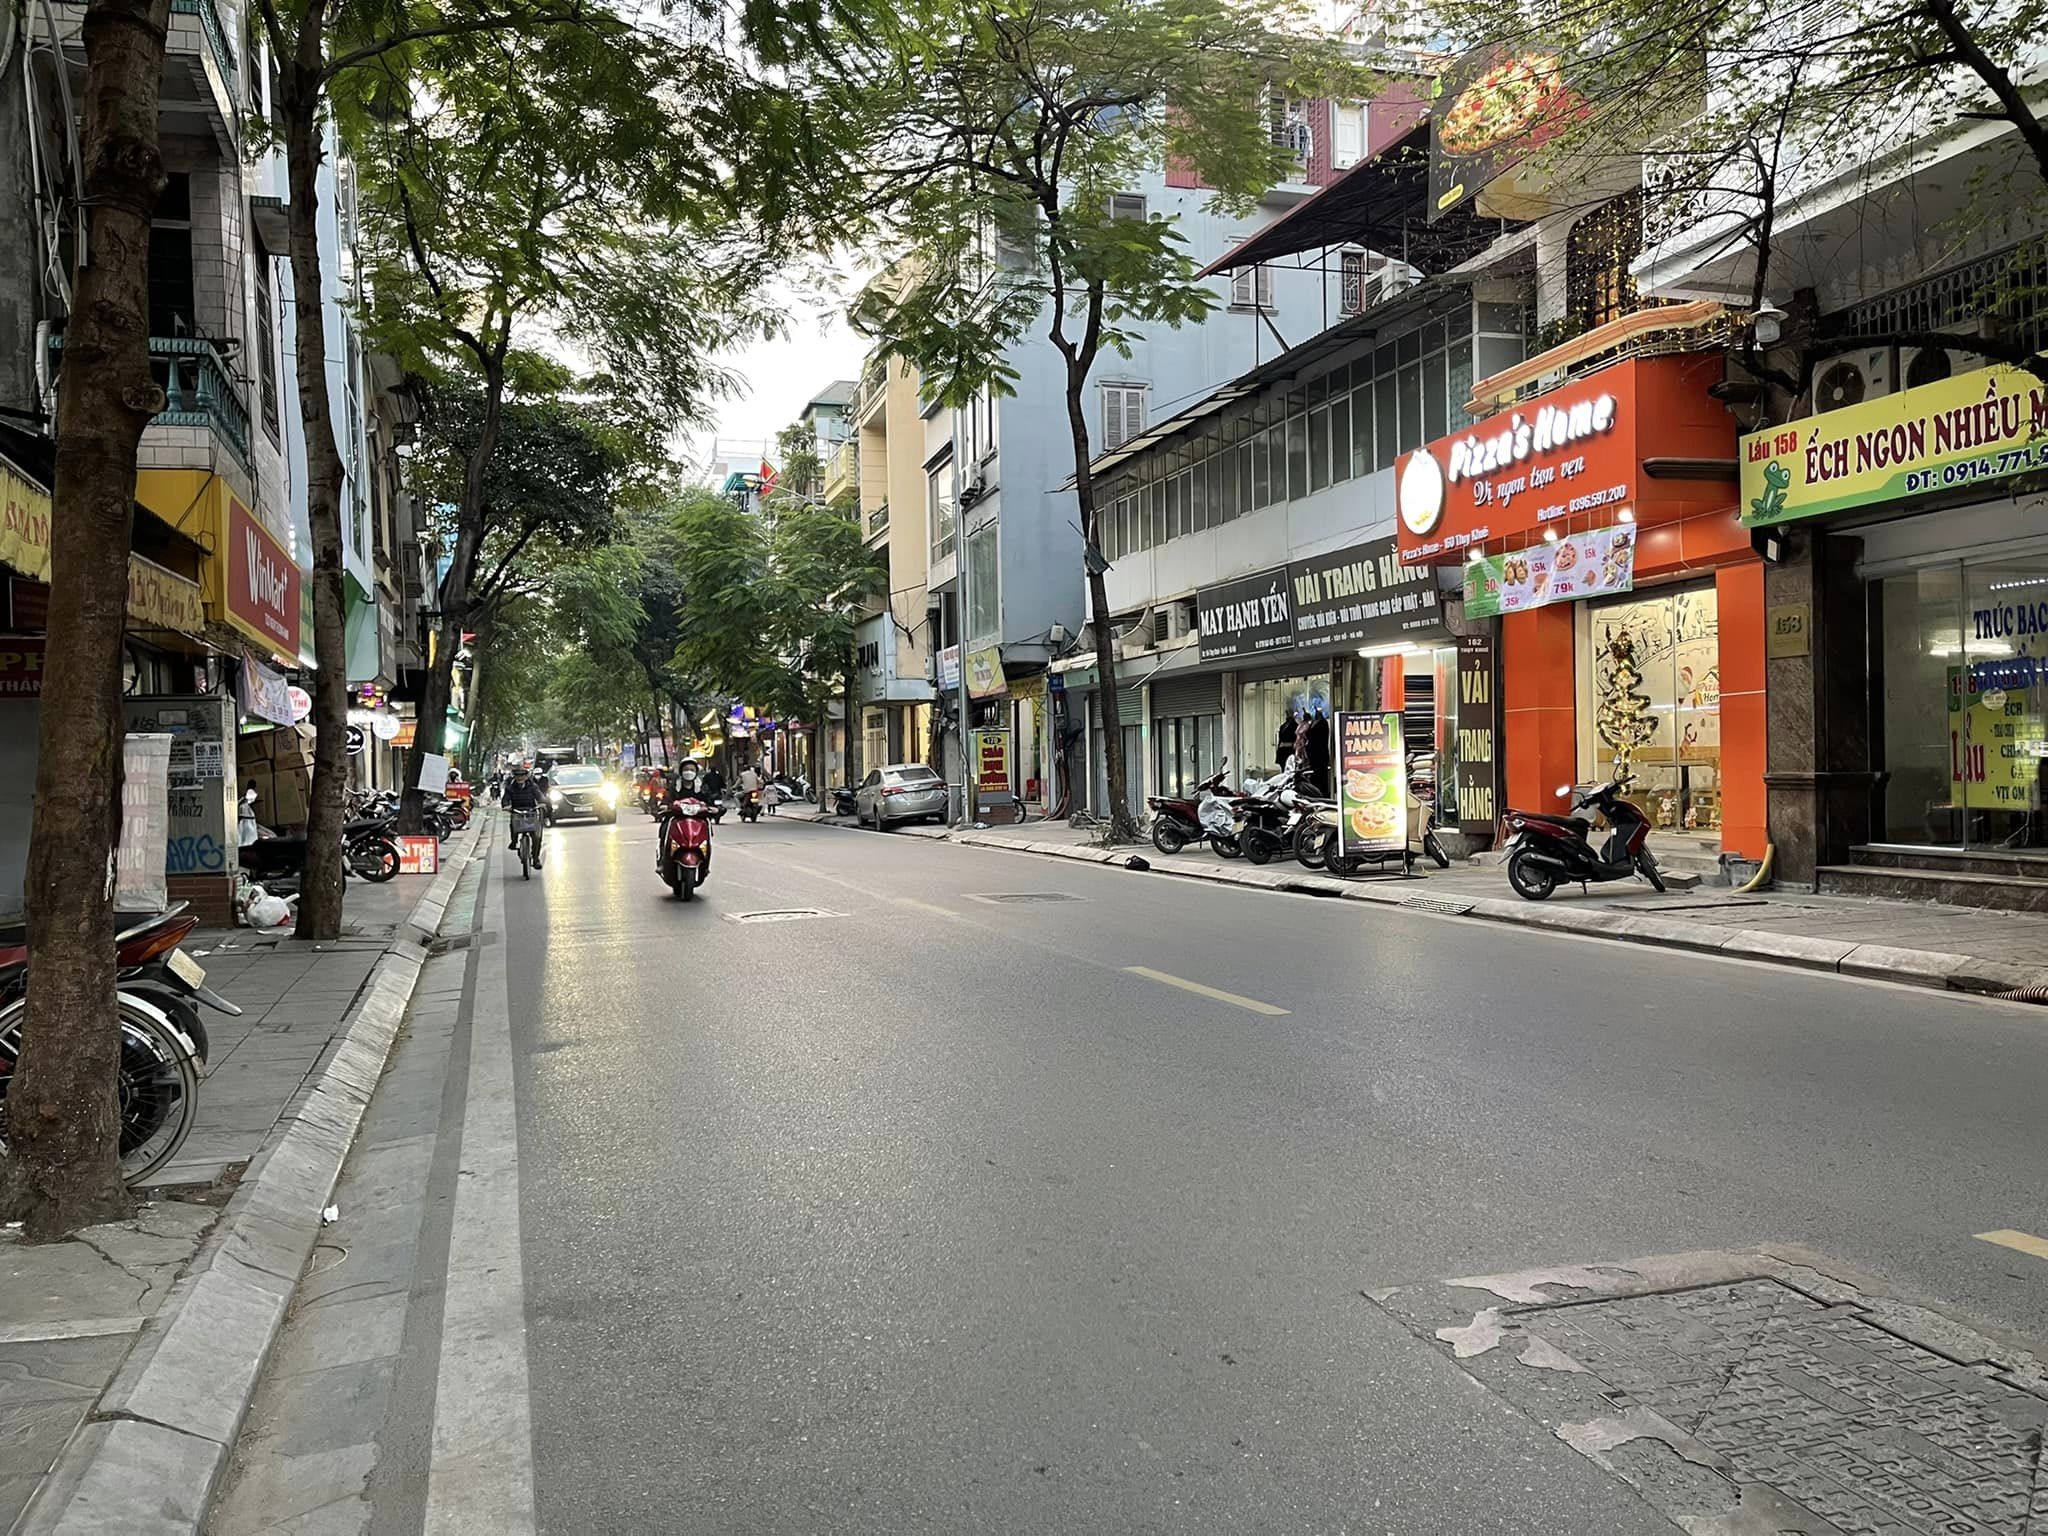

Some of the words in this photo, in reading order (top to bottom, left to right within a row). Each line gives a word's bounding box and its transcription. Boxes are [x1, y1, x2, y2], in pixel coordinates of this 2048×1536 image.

[1447, 413, 1533, 482] Pizza's
[1533, 394, 1616, 451] Home
[1748, 436, 1770, 463] Lẩu
[1774, 431, 1798, 455] 158
[1805, 427, 1849, 484] ẾCH
[1856, 418, 1926, 473] NGON
[1933, 377, 2020, 453] NHIỀU
[1473, 479, 1492, 506] Vị
[1497, 476, 1525, 506] ngon
[1530, 462, 1555, 490] trọn
[1560, 455, 1585, 480] vẹn
[1906, 469, 1938, 491] ĐT:
[1294, 567, 1320, 605] VẢI
[1323, 559, 1376, 599] TRANG
[1553, 582, 1574, 594] 79k
[1200, 606, 1224, 638] MAY
[1226, 598, 1260, 638] HẠNH
[1262, 581, 1289, 625] YẾN
[1775, 615, 1802, 635] 158
[1974, 601, 2014, 640] TRÚC
[1461, 659, 1488, 703] VẢI
[1345, 720, 1384, 736] MUA
[1382, 713, 1400, 752] 1
[1459, 729, 1492, 762] TRANG
